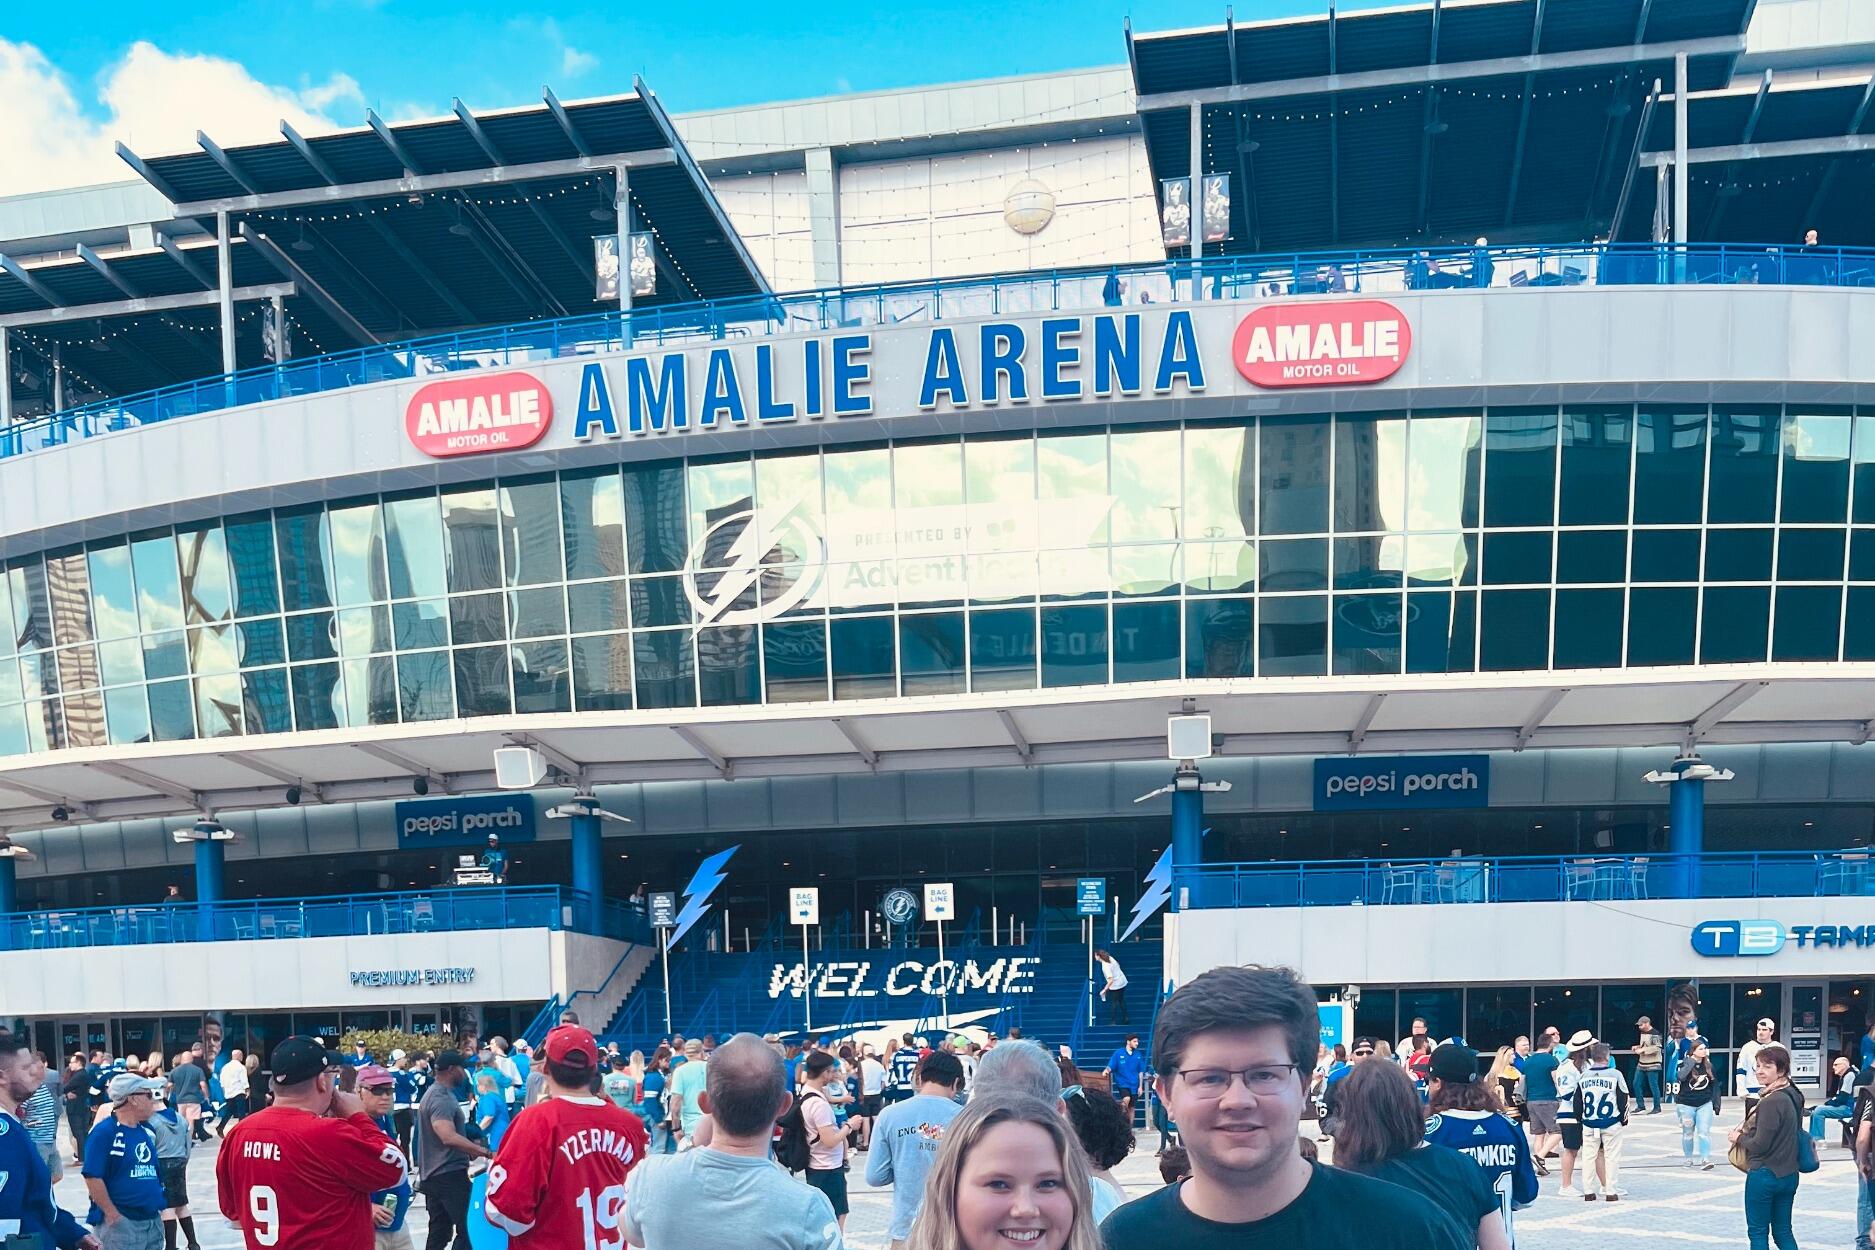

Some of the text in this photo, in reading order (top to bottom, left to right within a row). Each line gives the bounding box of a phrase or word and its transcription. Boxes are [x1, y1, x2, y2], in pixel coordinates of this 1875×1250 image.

[1245, 320, 1399, 364] AMALIE
[572, 310, 1207, 441] AMALIE ARENA
[1282, 362, 1361, 379] MOTOR OIL
[416, 389, 541, 437] AMALIE
[447, 432, 509, 449] MOTOR OIL
[954, 526, 973, 540] BY
[1327, 767, 1478, 798] pepsi porch
[404, 806, 523, 837] pepsi porch
[350, 967, 475, 987] PREMIUM ENTRY
[768, 957, 1041, 999] WELCOME
[1581, 1078, 1613, 1090] KUCHEROV
[1583, 1091, 1614, 1119] 86
[243, 1141, 281, 1161] HOWE
[559, 1128, 634, 1165] YZERMAN
[250, 1185, 280, 1247] 9
[1493, 1170, 1514, 1247] 1
